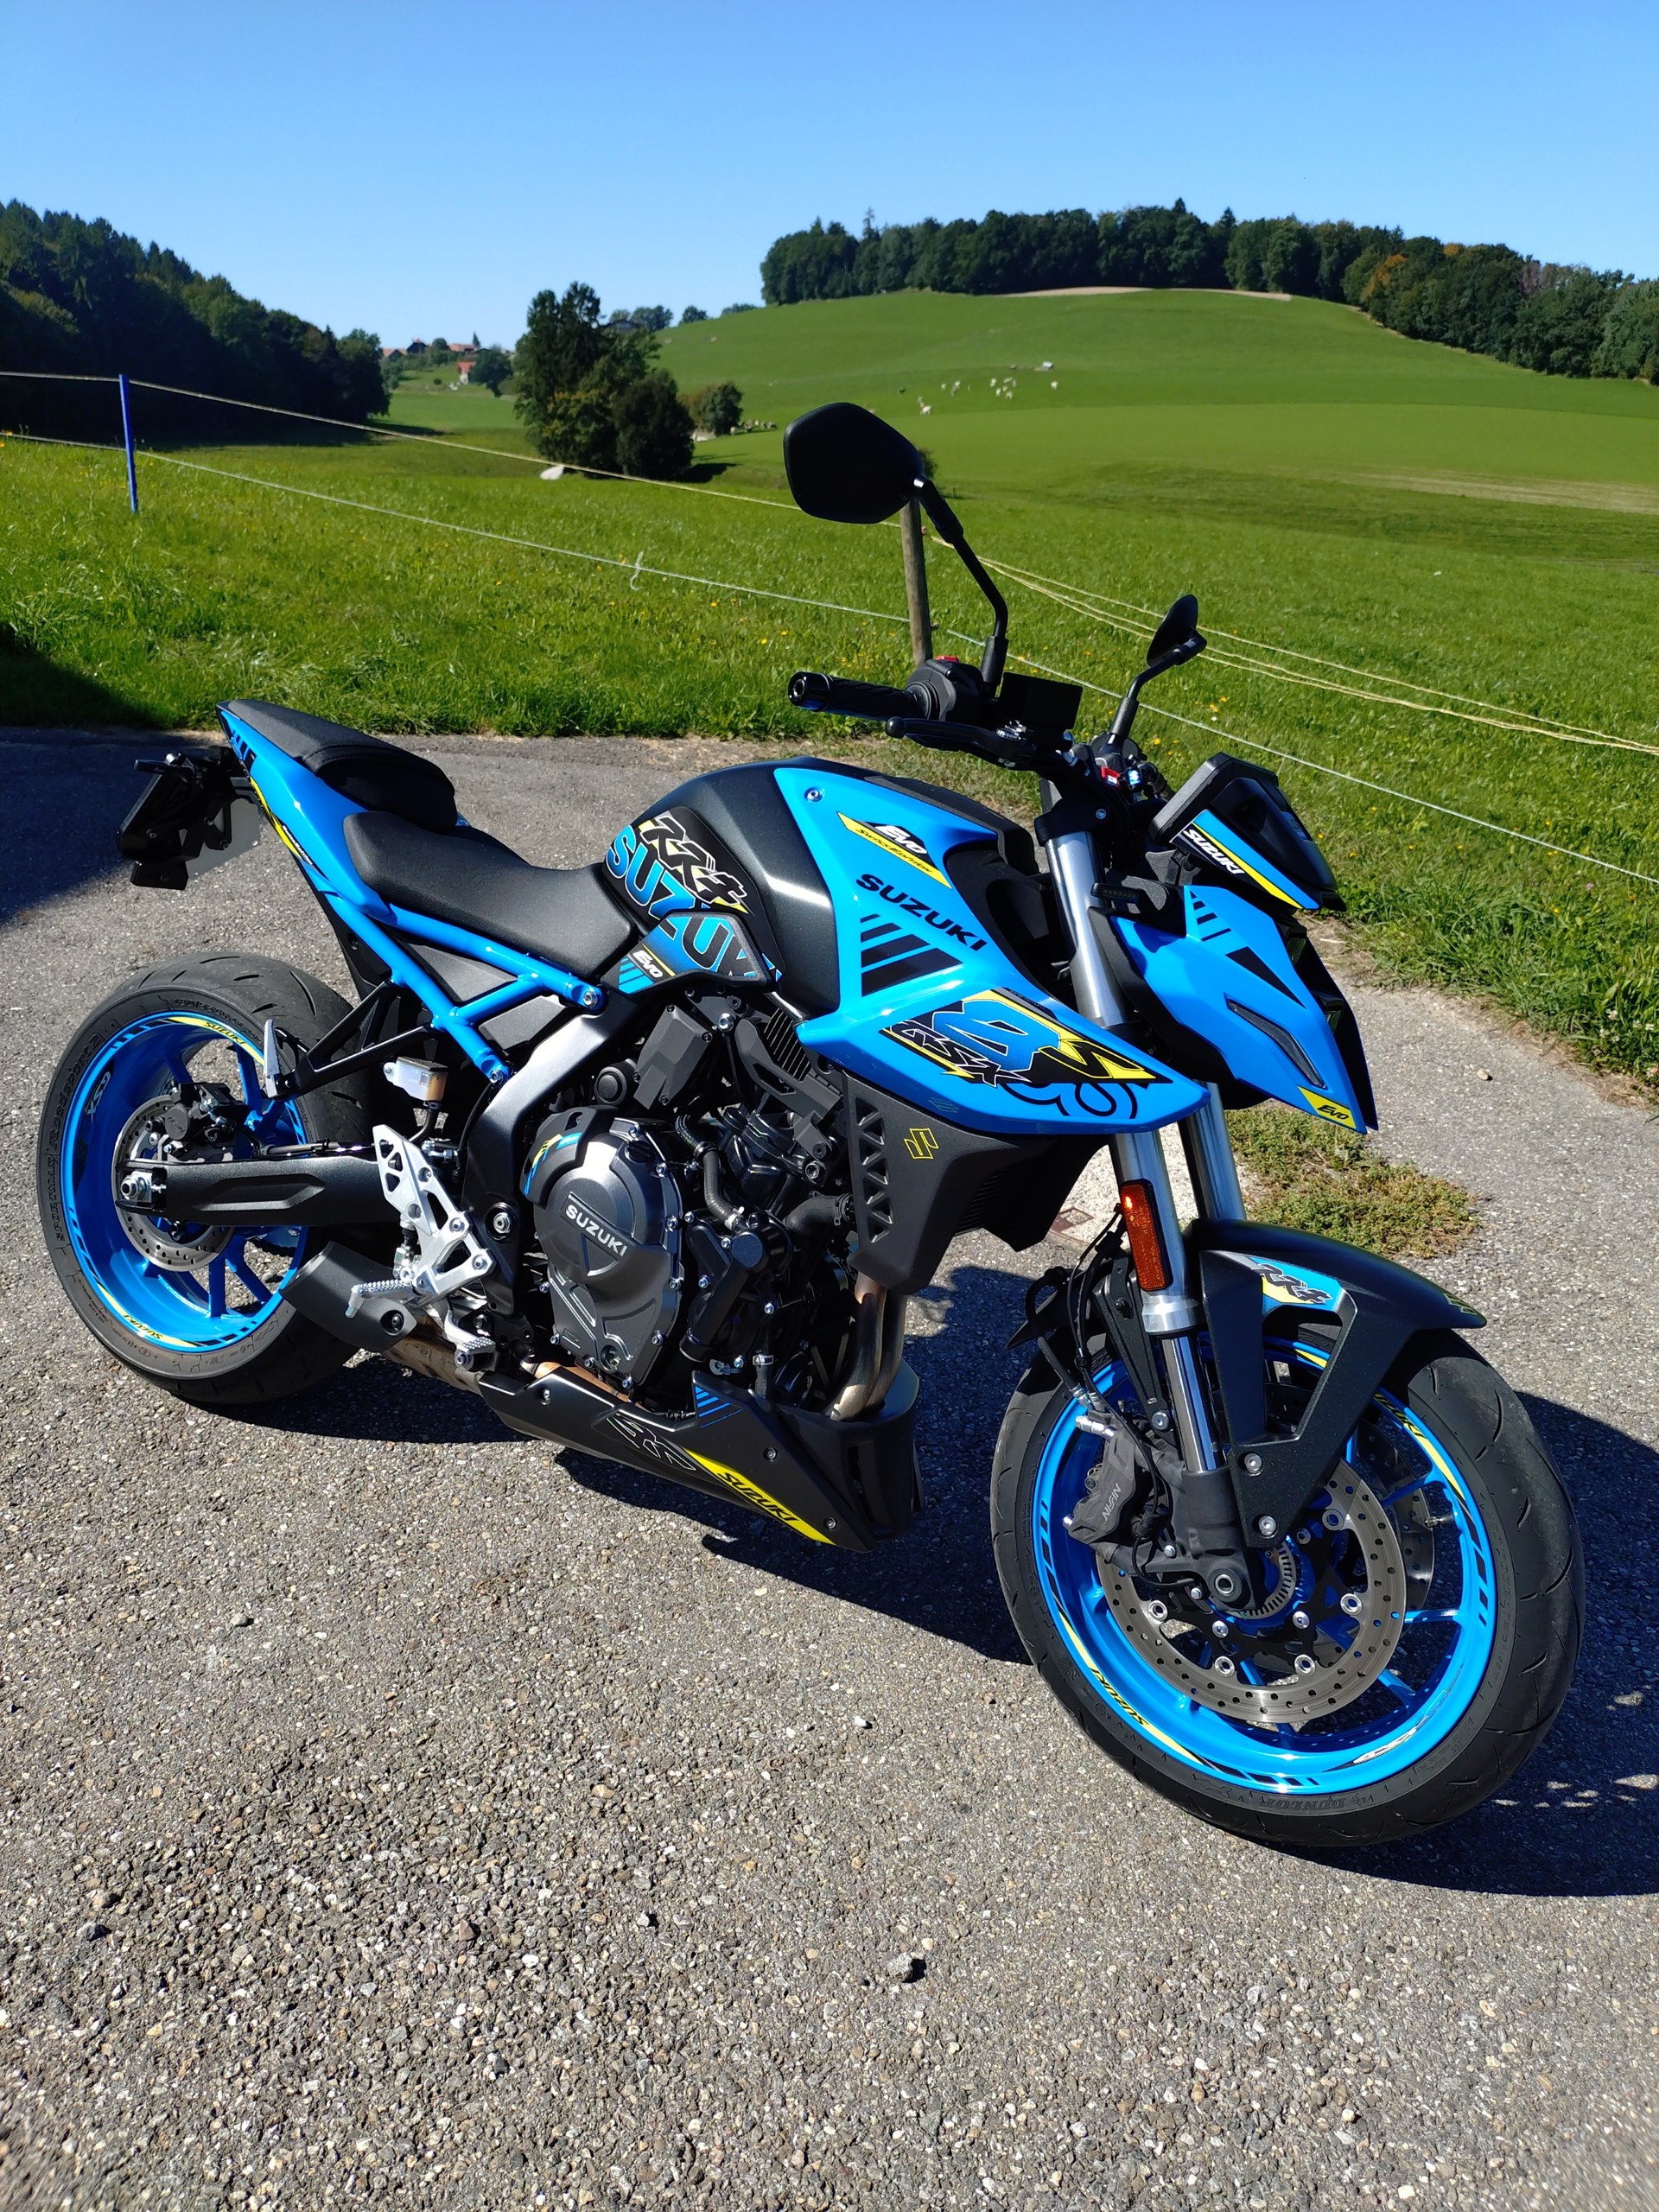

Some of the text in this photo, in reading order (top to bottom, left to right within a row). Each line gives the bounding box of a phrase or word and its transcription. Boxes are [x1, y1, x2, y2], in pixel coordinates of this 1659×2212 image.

[1183, 828, 1245, 875] SUZUKI
[855, 873, 988, 952] SUZUKI
[204, 1020, 246, 1046] SUZUKI
[564, 1204, 628, 1258] SUZUKI
[123, 1313, 165, 1340] SUZUKI
[716, 1471, 798, 1523] SUZUKI
[1102, 1482, 1122, 1522] NISSIN
[1259, 1796, 1346, 1812] DUNLOP
